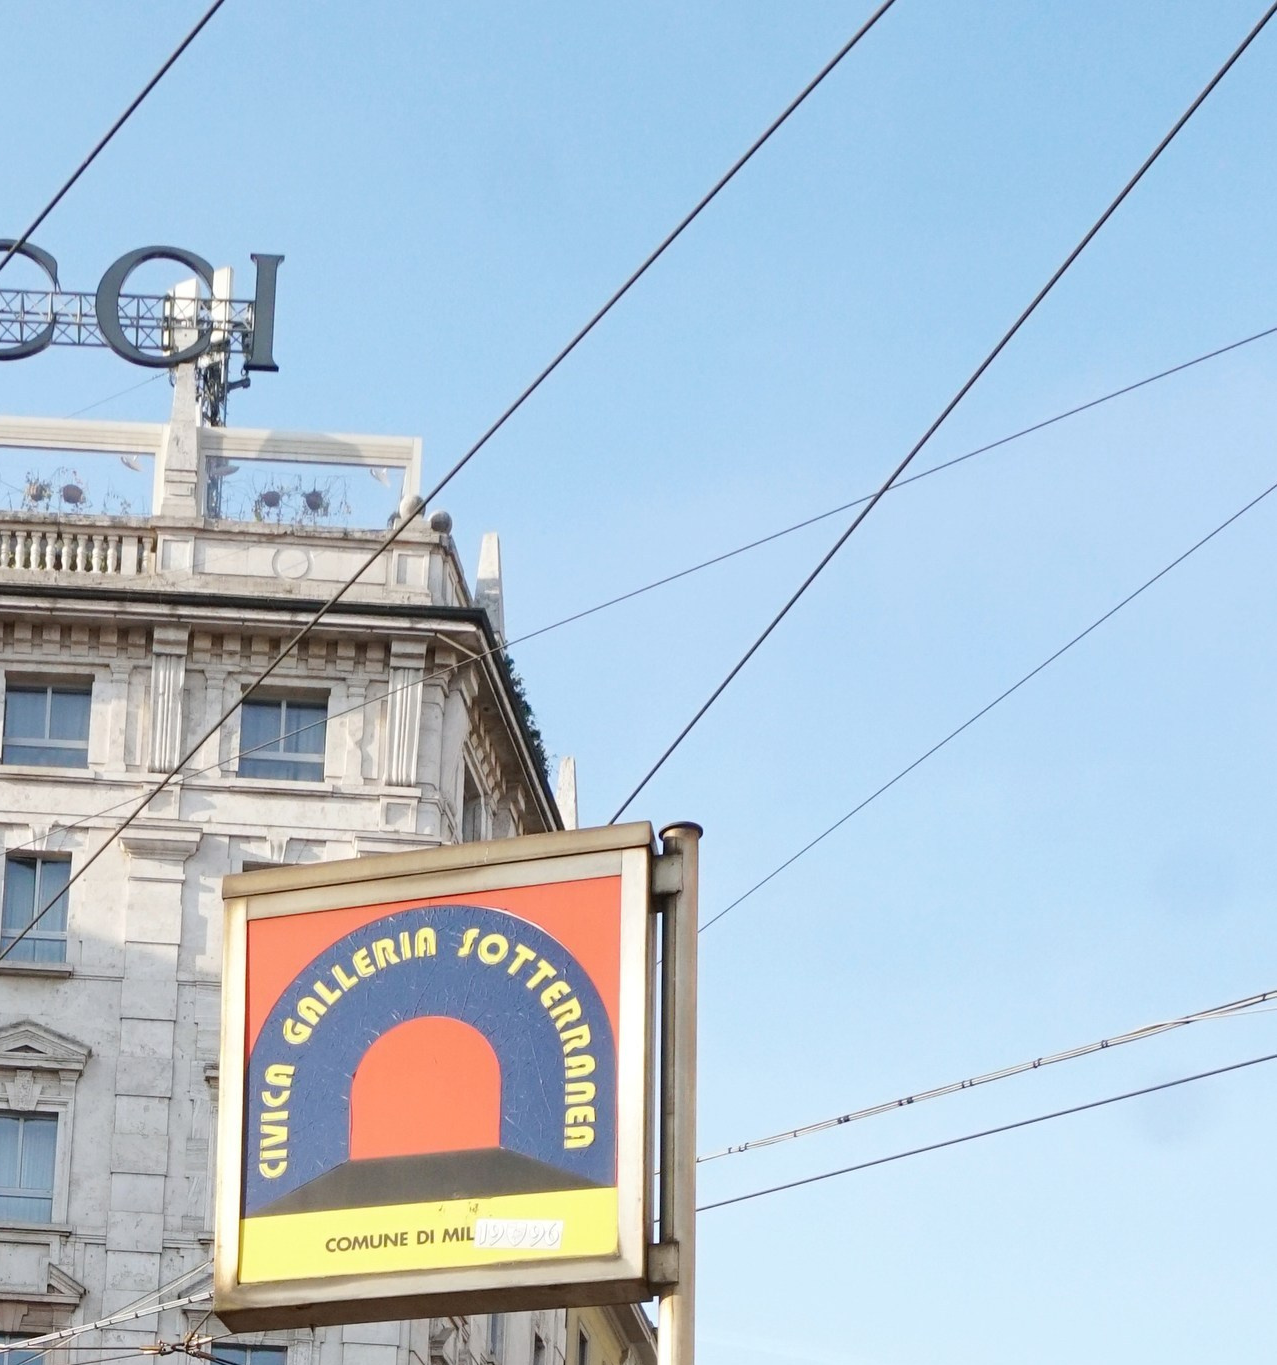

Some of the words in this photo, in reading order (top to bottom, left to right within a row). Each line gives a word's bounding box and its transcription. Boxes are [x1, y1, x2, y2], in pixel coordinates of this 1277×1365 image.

[259, 1063, 296, 1179] CIVICA
[282, 927, 437, 1045] GALLERIA
[457, 928, 597, 1150] SOTTERRANEA
[325, 1232, 409, 1252] COMUNE
[416, 1230, 435, 1245] DI
[442, 1227, 475, 1243] MIL
